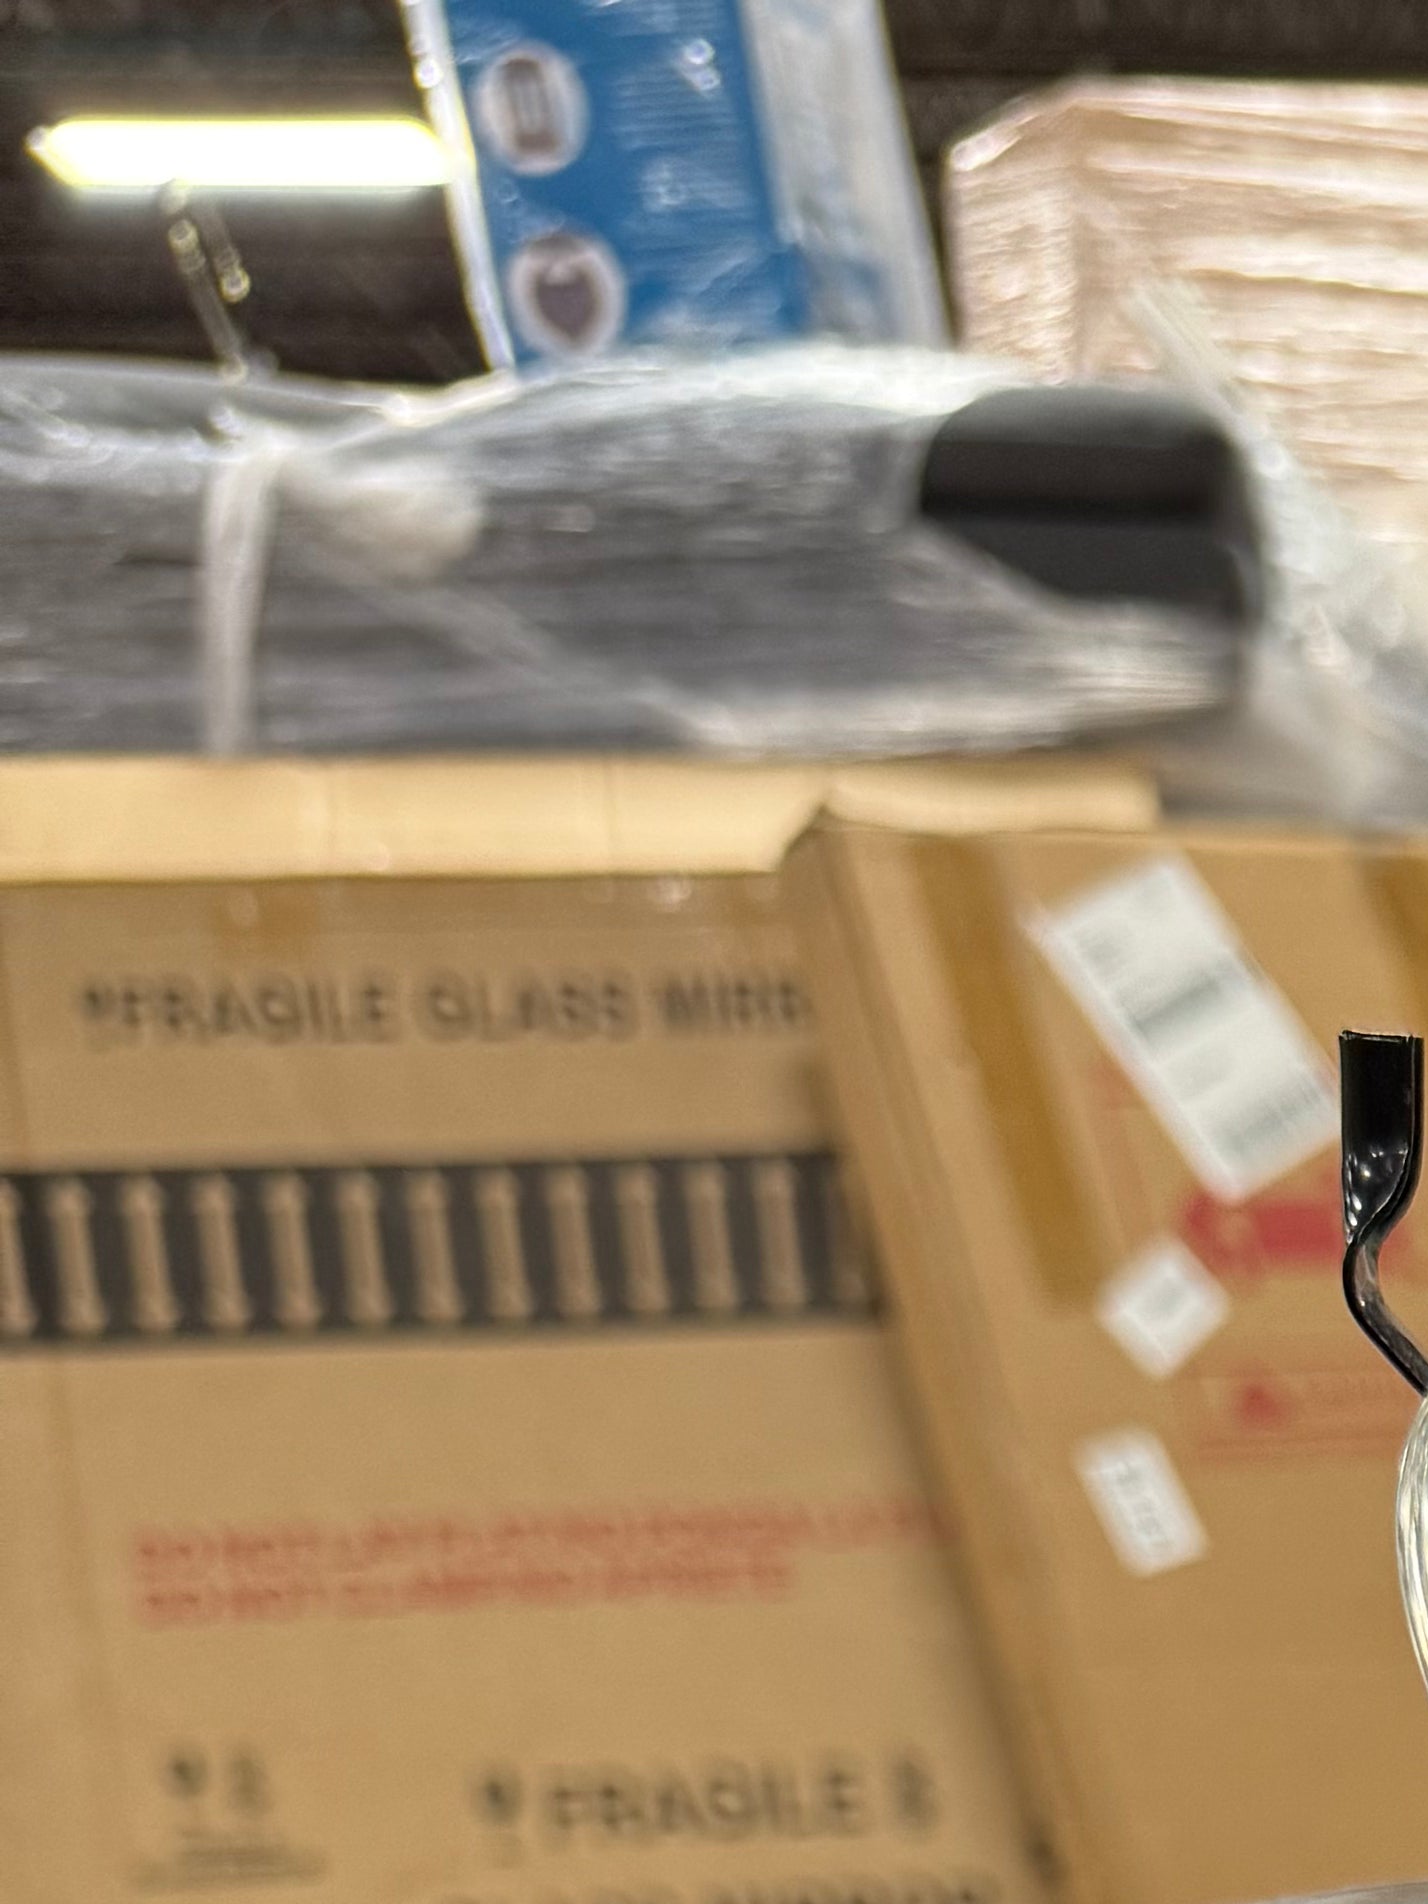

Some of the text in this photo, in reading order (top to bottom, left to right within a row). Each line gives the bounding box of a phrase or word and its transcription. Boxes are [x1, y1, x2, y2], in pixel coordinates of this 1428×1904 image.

[117, 972, 393, 1044] FRAGILE
[417, 970, 625, 1043] GLASS
[543, 1752, 866, 1846] FRAGILE
